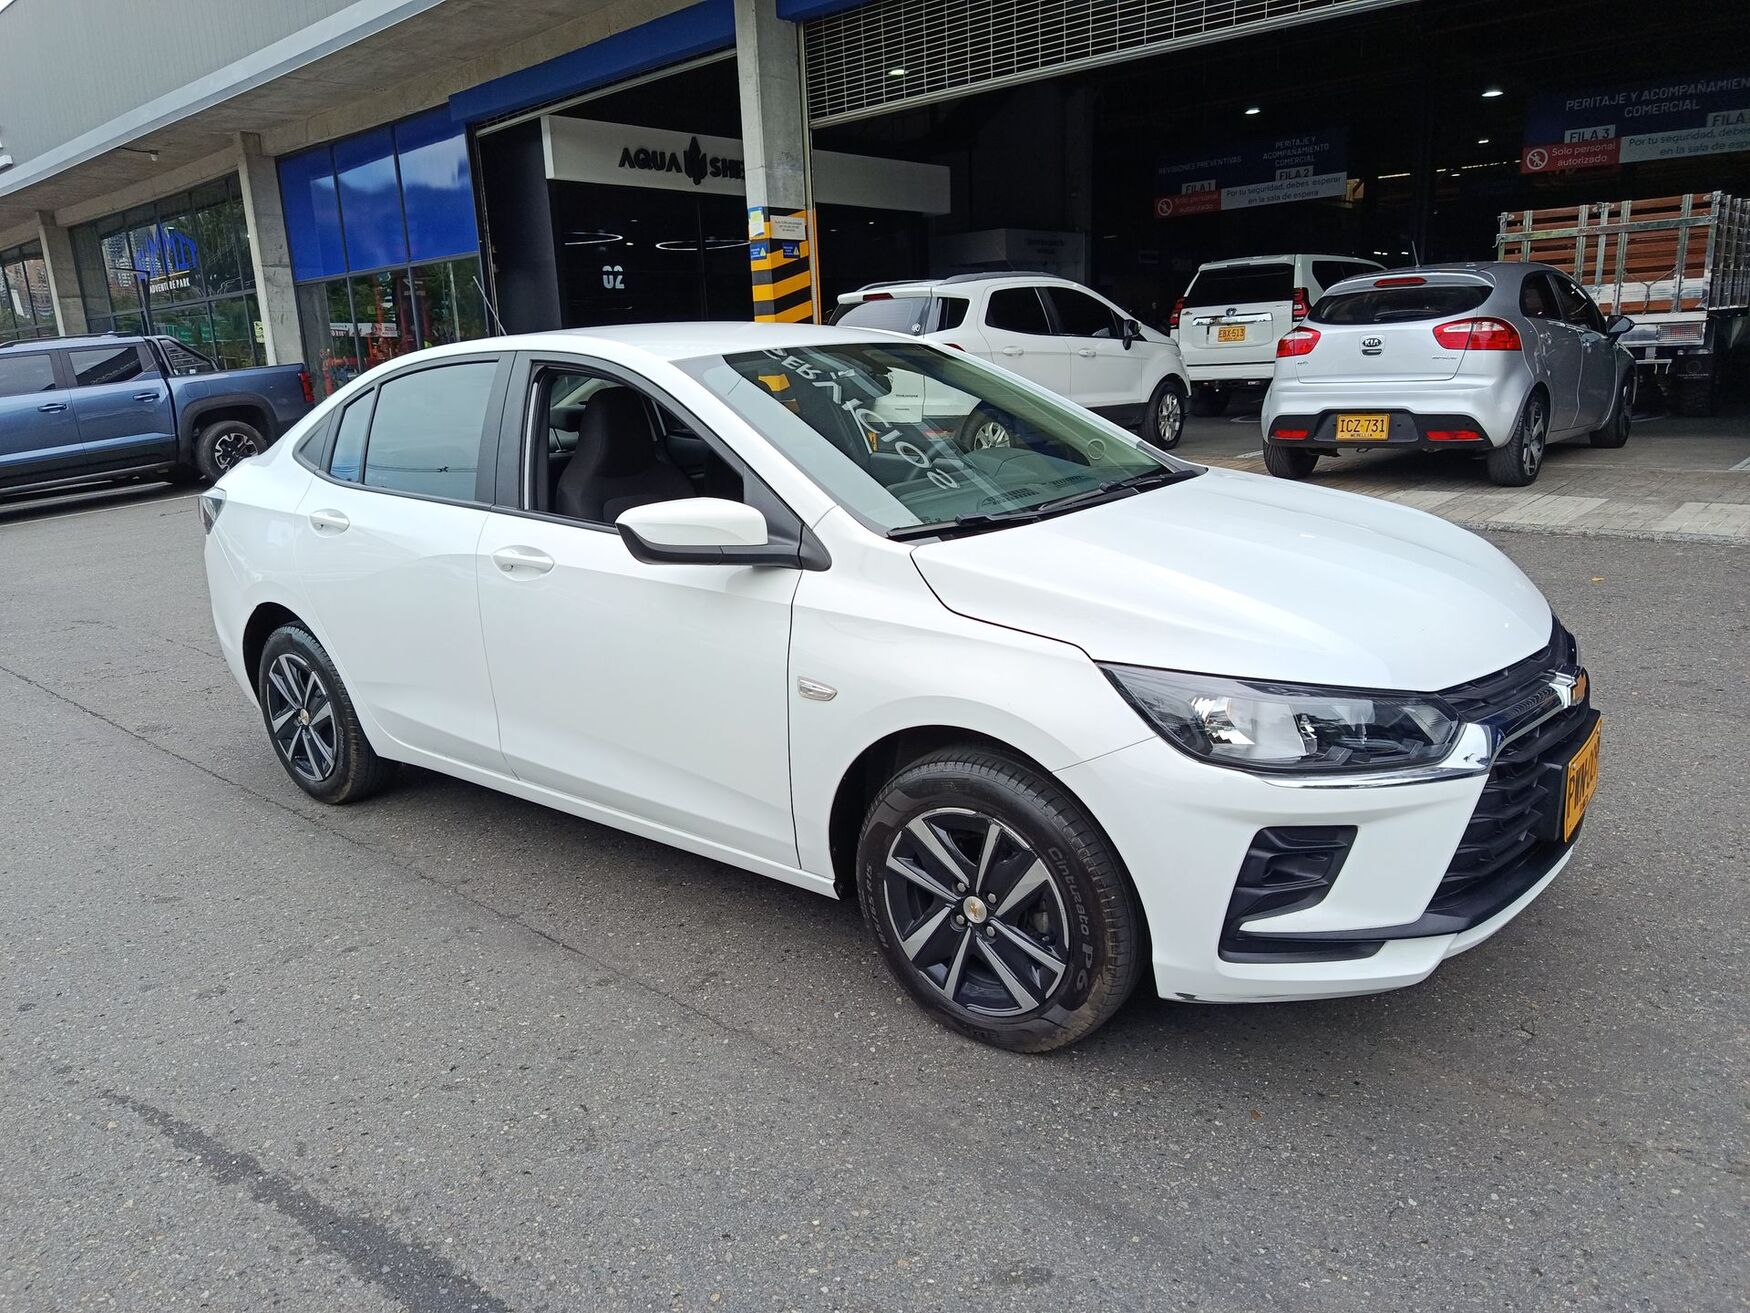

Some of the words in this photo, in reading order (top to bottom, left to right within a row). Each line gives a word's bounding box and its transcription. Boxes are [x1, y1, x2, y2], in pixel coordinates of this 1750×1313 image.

[1565, 93, 1627, 111] PERITAJE
[1630, 91, 1640, 102] Y
[1624, 99, 1701, 118] COMERCIAL
[1712, 112, 1744, 126] FILA
[1569, 130, 1598, 144] FILA
[1602, 128, 1610, 139] 3
[1552, 147, 1573, 156] Solo
[1574, 142, 1616, 155] personal
[618, 147, 683, 173] AQUA
[1557, 154, 1608, 167] autorizado
[1279, 170, 1303, 180] FILA
[1185, 185, 1207, 194] FILA
[177, 277, 191, 288] PARK
[602, 265, 625, 289] 02
[1074, 943, 1096, 992] P6
